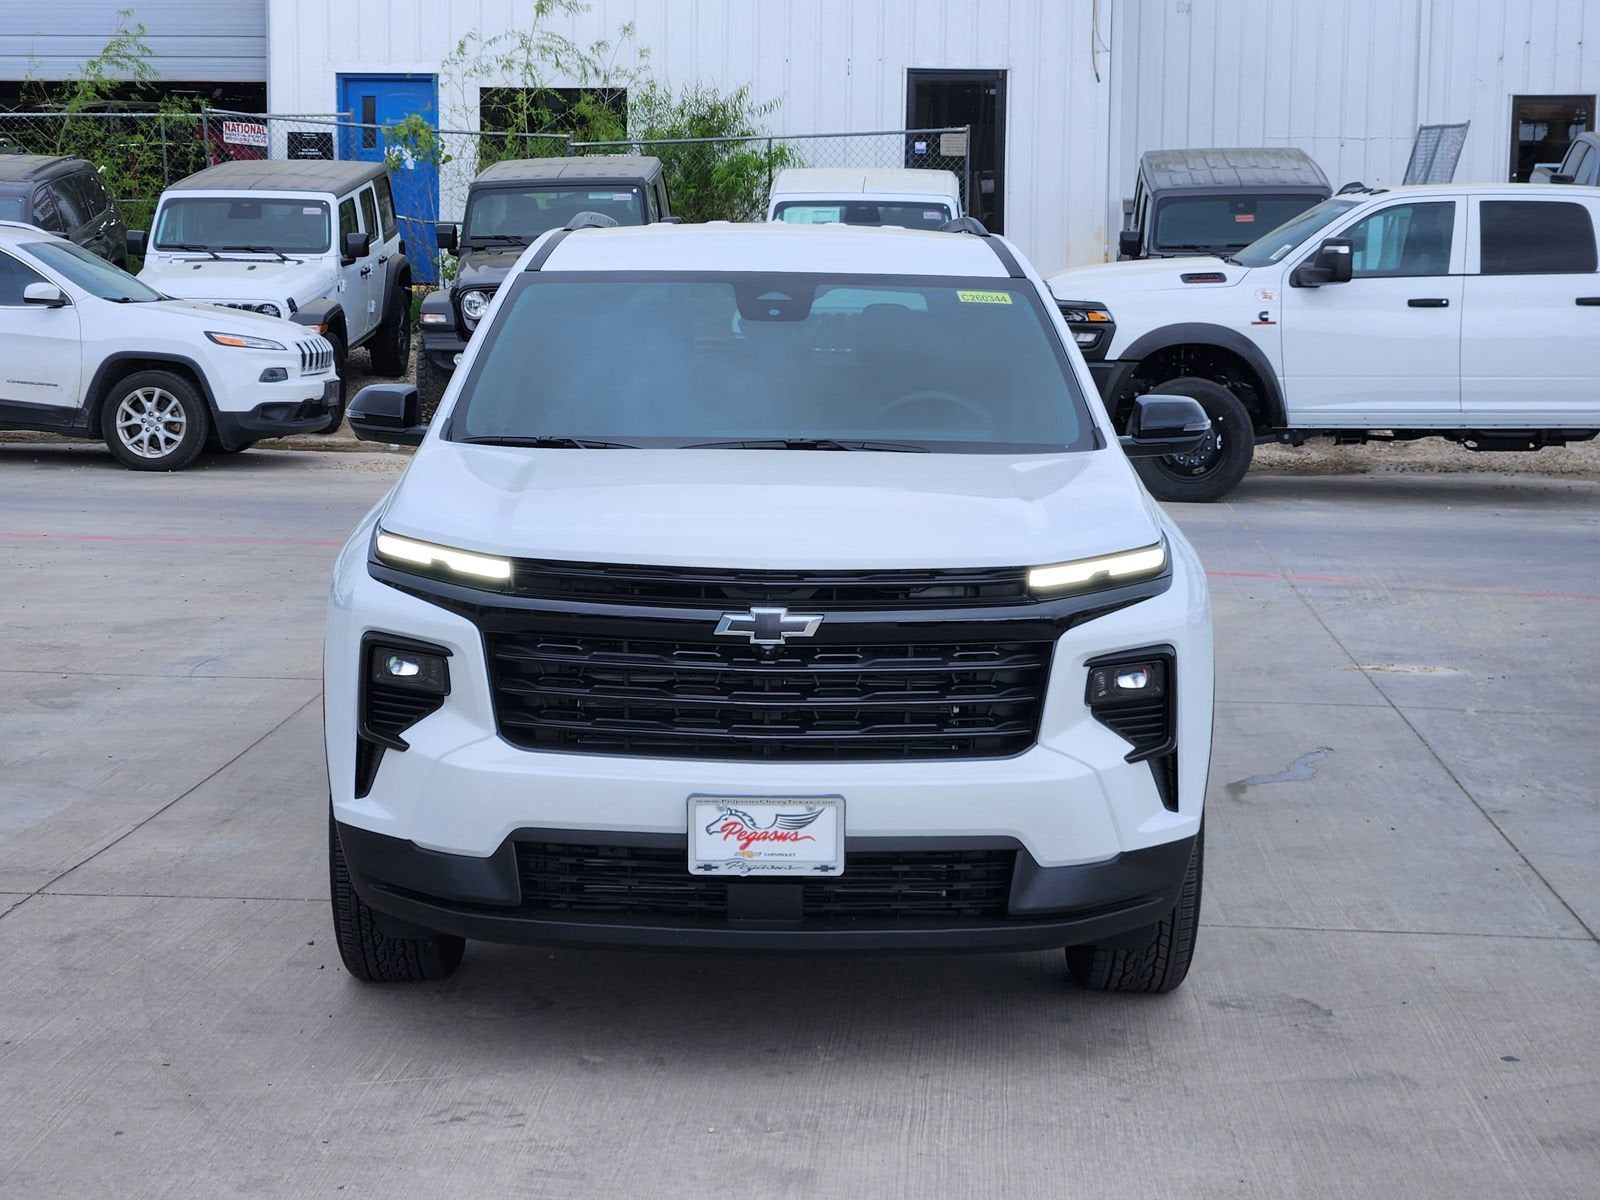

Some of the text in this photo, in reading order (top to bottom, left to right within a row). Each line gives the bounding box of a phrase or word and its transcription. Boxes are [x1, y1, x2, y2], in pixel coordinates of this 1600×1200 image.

[224, 123, 267, 136] NATIONAL
[720, 821, 815, 850] Pegasus
[725, 861, 806, 874] Pegasus
